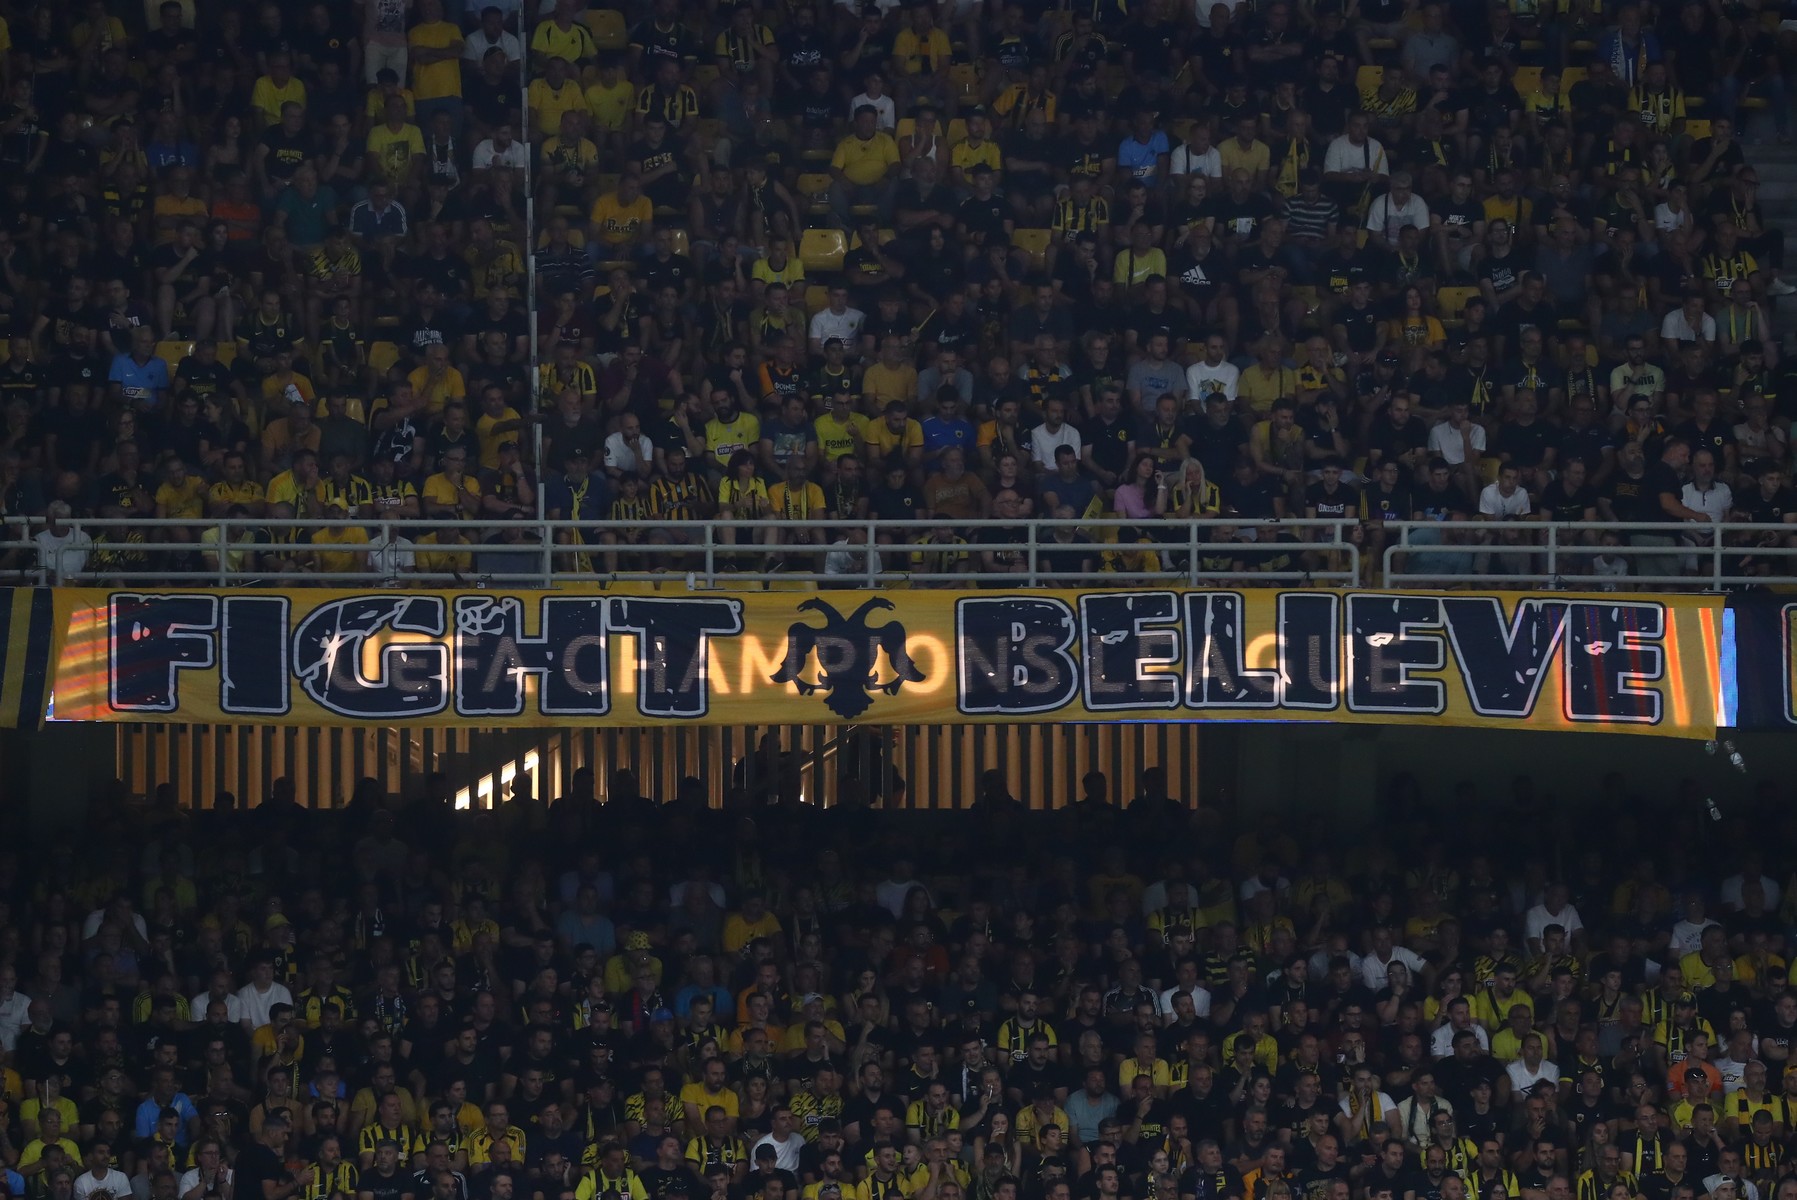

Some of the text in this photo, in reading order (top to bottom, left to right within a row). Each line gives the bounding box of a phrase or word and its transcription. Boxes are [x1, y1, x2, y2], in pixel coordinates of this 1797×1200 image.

[1180, 276, 1211, 285] adidas
[1624, 375, 1655, 386] PMA
[107, 591, 744, 719] FIGHT
[954, 589, 1665, 725] BELIEVE
[562, 633, 1061, 694] CHAMPIONS
[1089, 632, 1406, 694] LEAGUE
